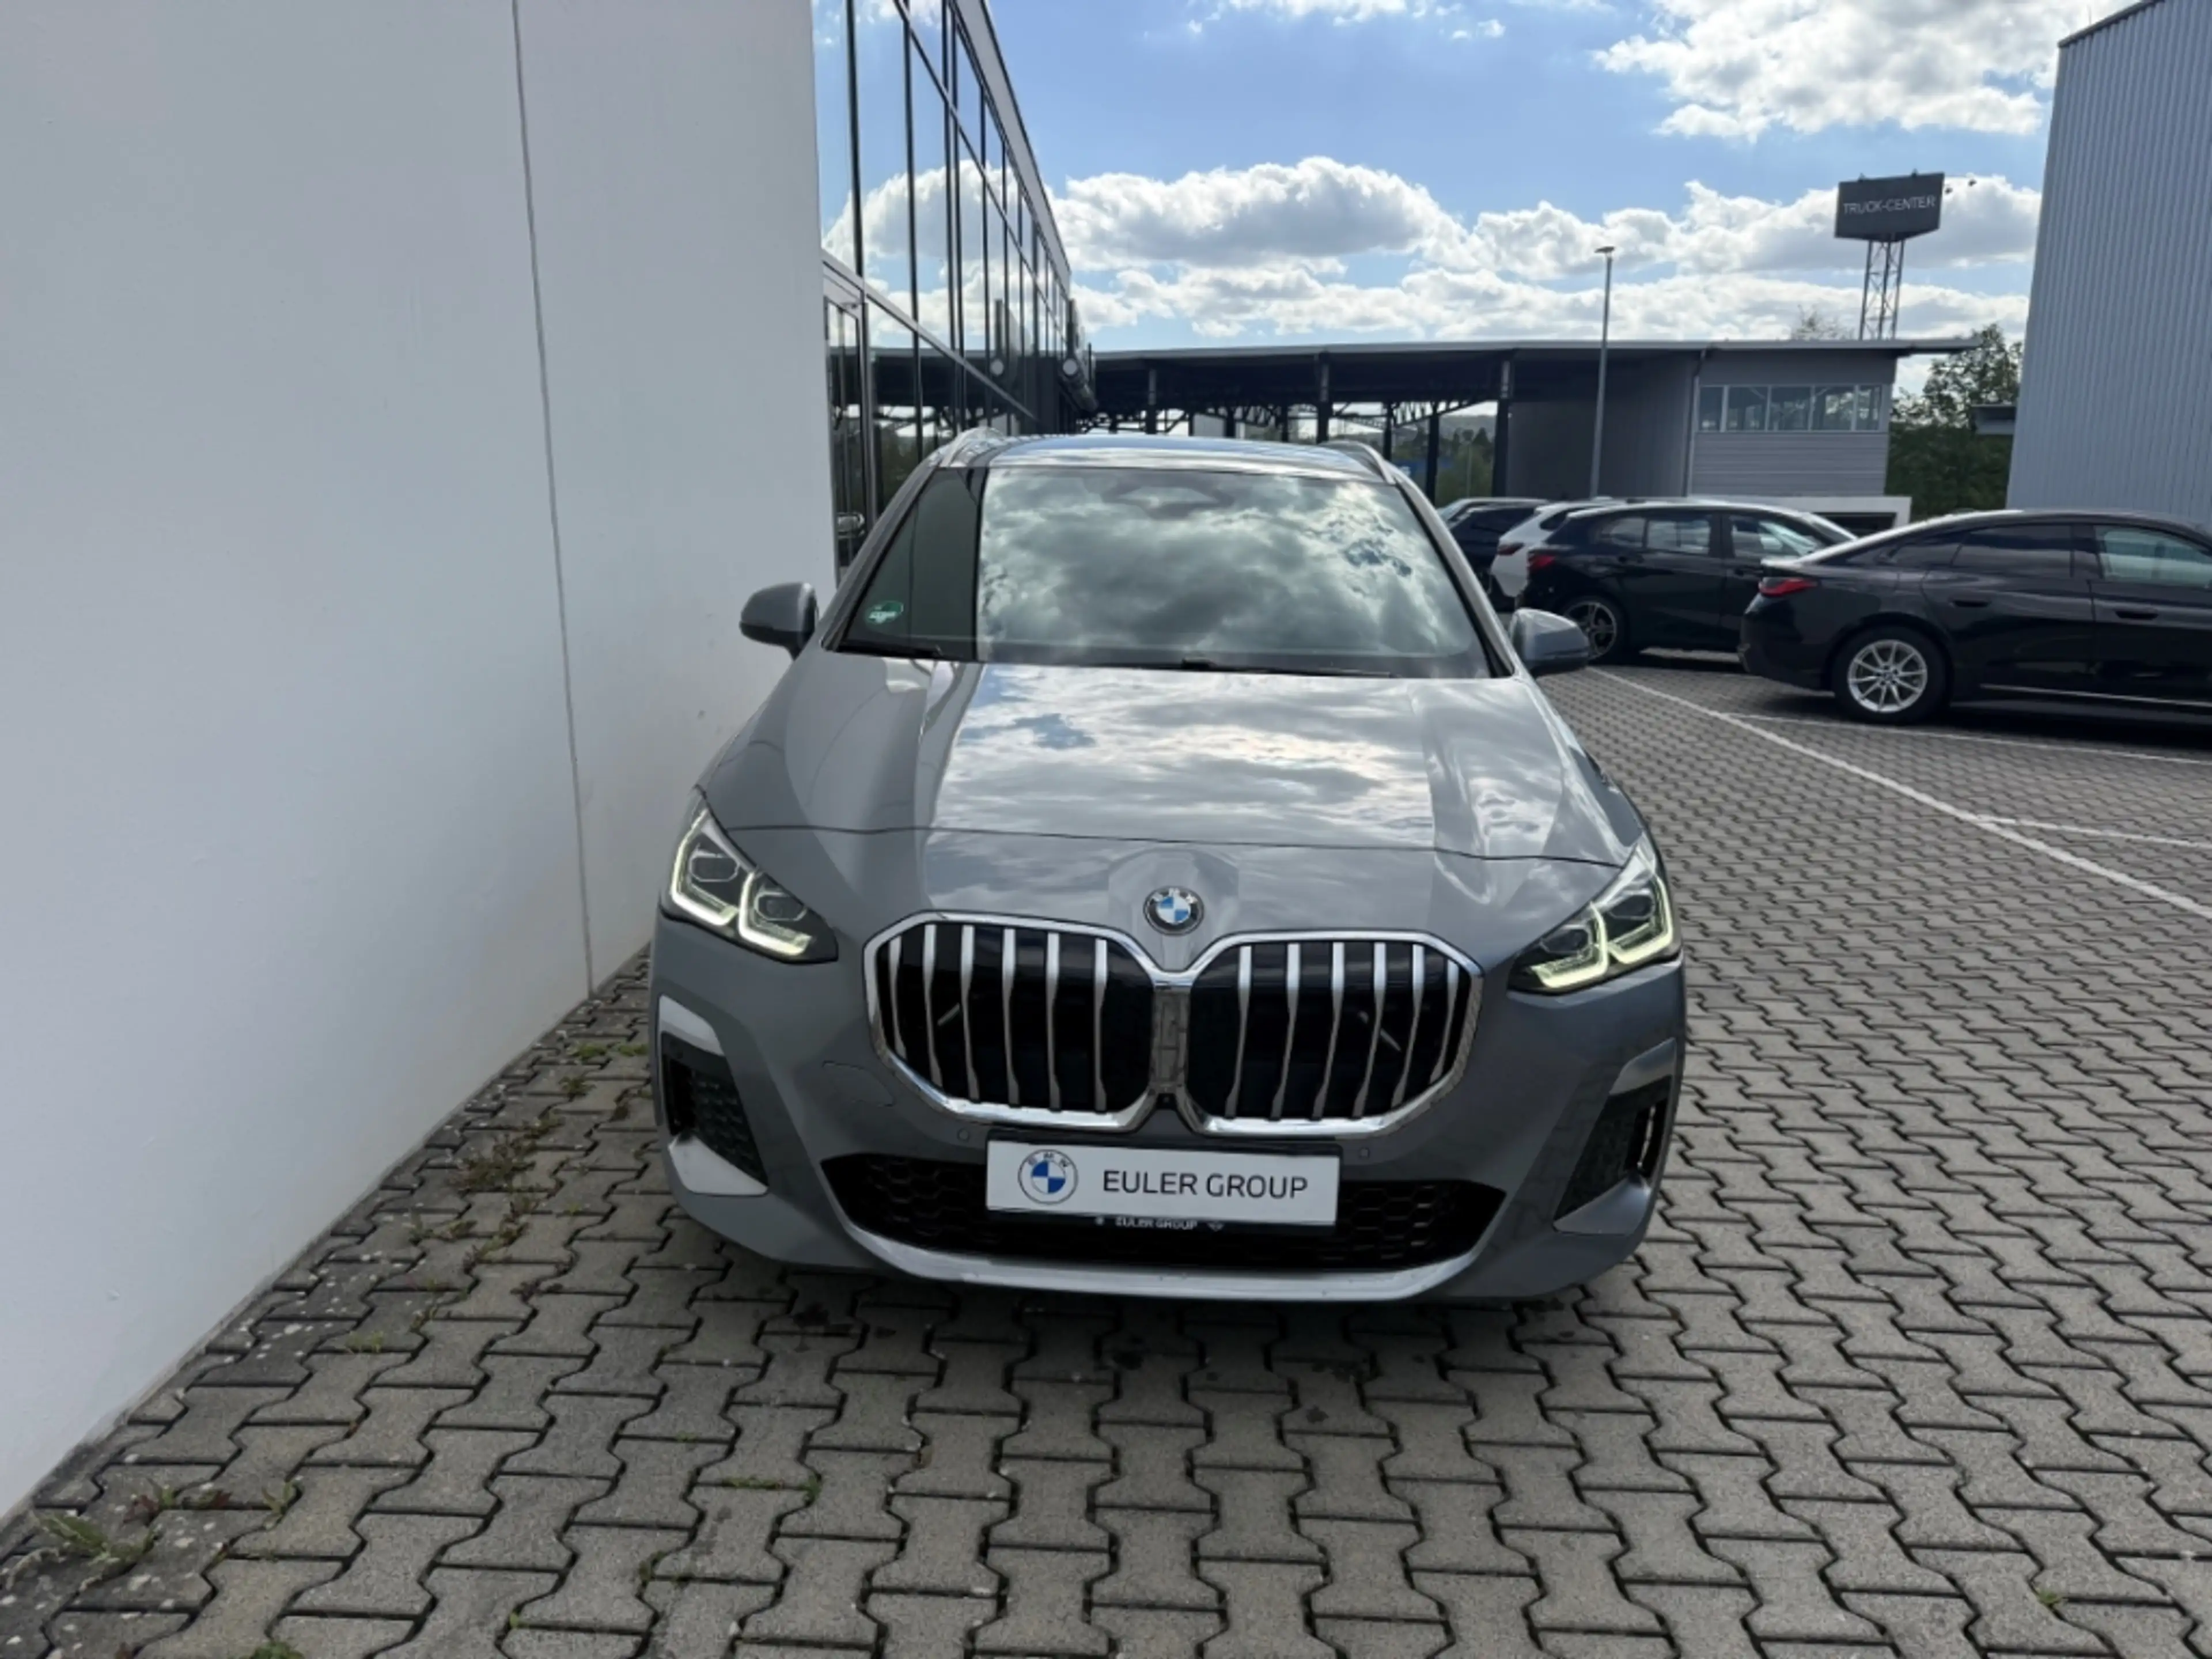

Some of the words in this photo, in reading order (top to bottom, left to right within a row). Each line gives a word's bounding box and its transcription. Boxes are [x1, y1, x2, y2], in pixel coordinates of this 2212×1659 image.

[1843, 195, 1937, 214] TRUCK-CENTER
[1103, 1170, 1198, 1195] EULER
[1206, 1173, 1308, 1199] GROUP
[1115, 1215, 1154, 1228] EULER
[1156, 1219, 1198, 1230] GROUP
